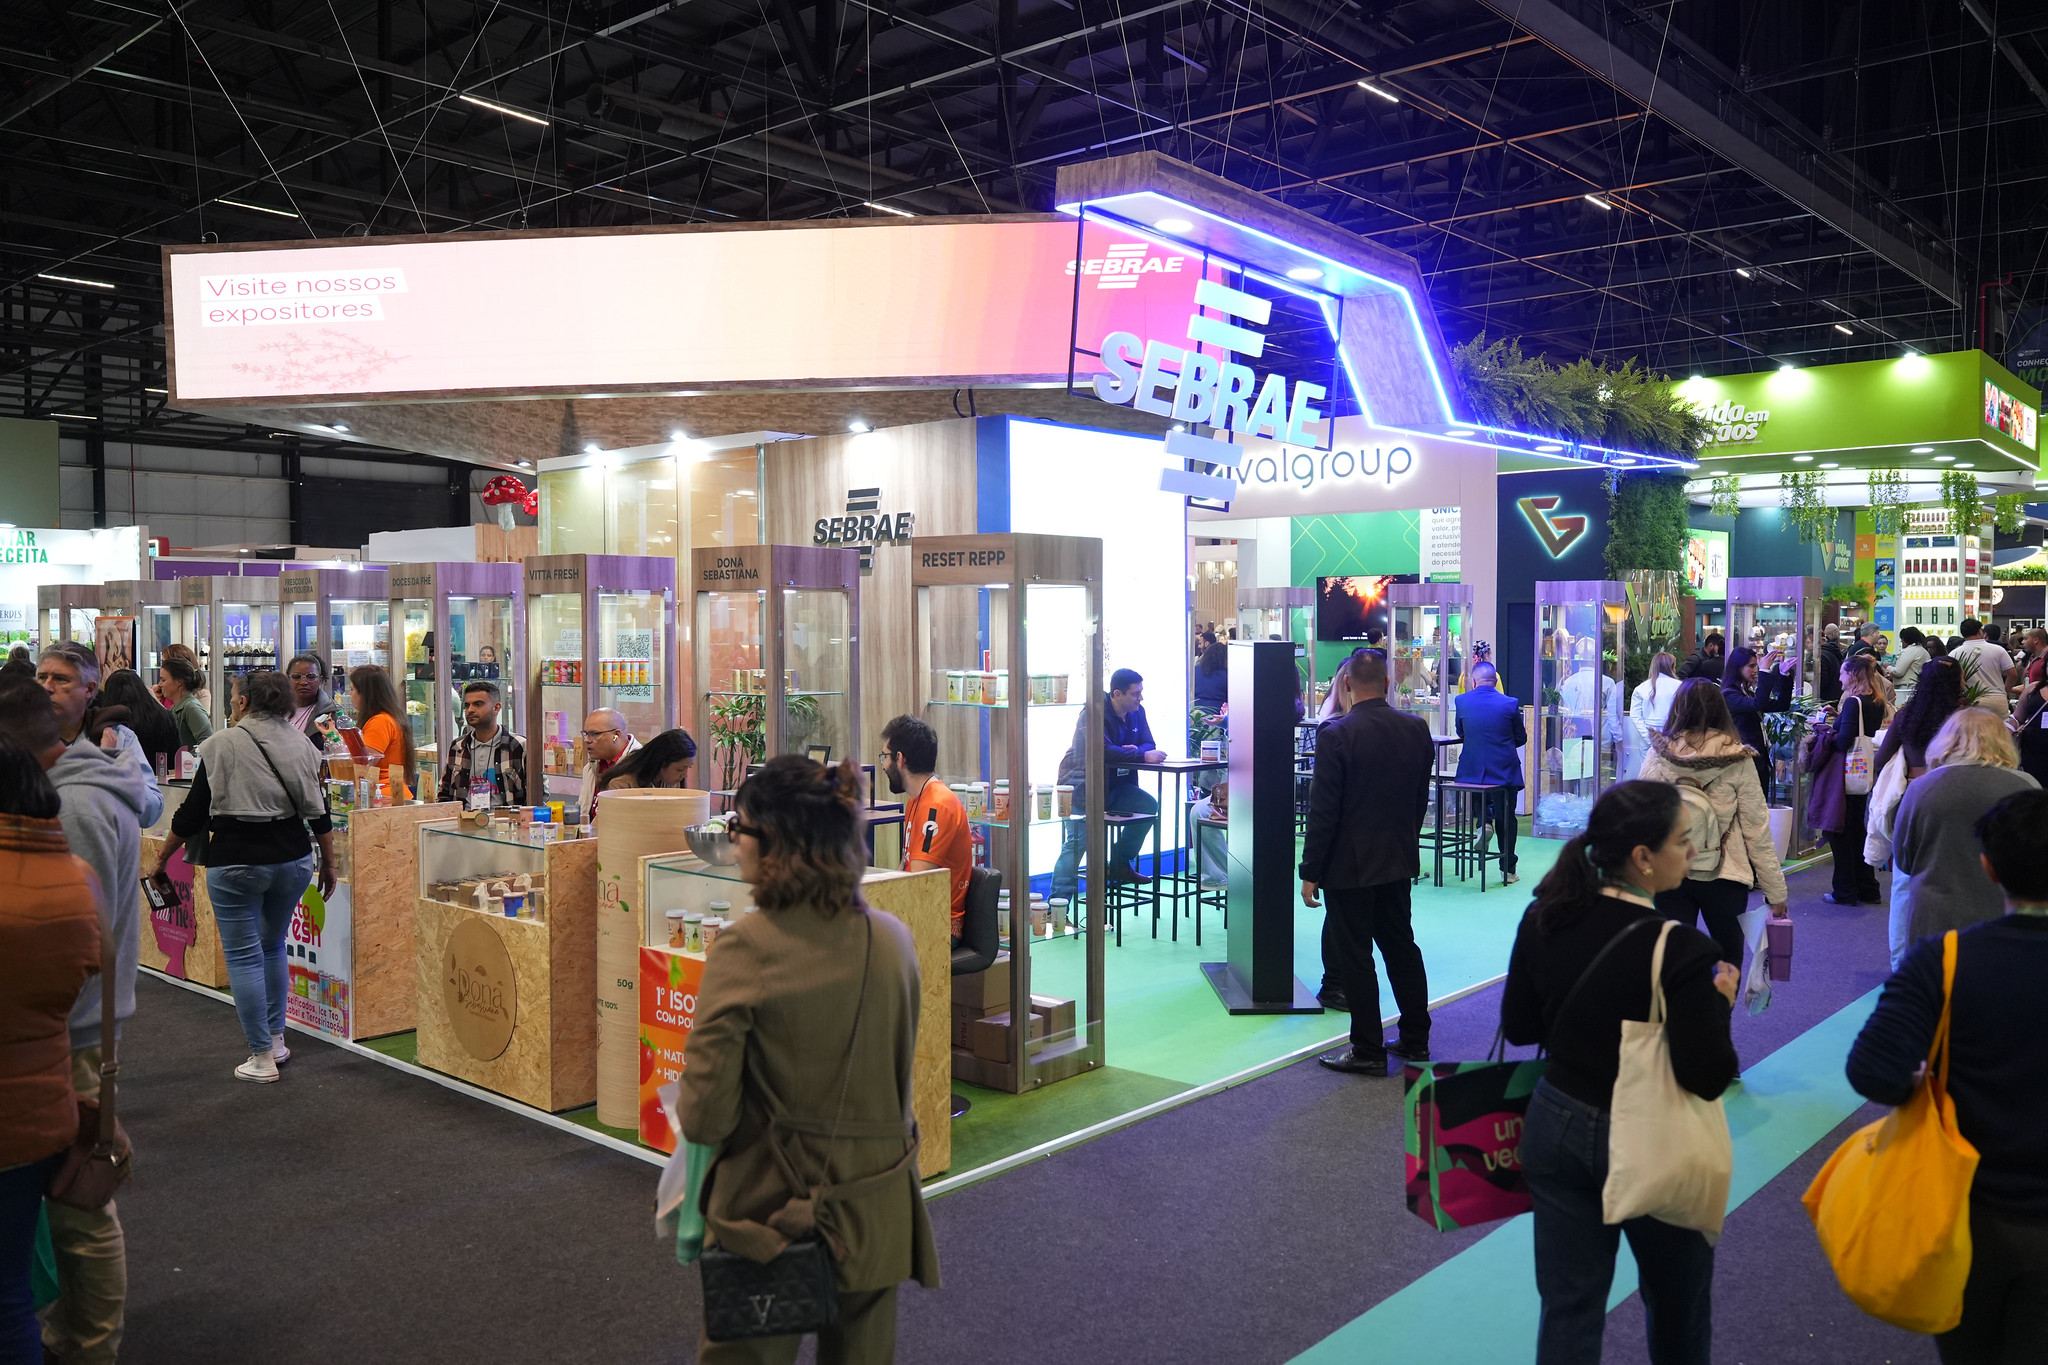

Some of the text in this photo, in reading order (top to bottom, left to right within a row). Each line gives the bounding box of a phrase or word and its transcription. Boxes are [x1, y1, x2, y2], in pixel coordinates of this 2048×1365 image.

[1064, 256, 1185, 276] SEBRAE
[207, 273, 396, 297] Visite nossos
[208, 301, 374, 326] expositores
[1093, 331, 1327, 449] SEBRAE
[1744, 410, 1769, 423] em
[1236, 446, 1412, 489] valgroup
[813, 512, 914, 544] SEBRAE
[717, 557, 744, 569] DONA
[922, 550, 1006, 569] RESET REPP
[284, 577, 312, 586] FRESCOR DA
[392, 574, 432, 587] DOCES DA FHÊ
[528, 568, 580, 581] VITTA FRESH
[703, 568, 759, 580] SEBASTIANA
[283, 585, 314, 595] MANTIQUEIRA
[458, 968, 503, 1009] Dona
[617, 978, 633, 990] 50g
[319, 1005, 327, 1017] Ice
[656, 1009, 676, 1025] COM
[306, 1010, 345, 1035] Terceirização
